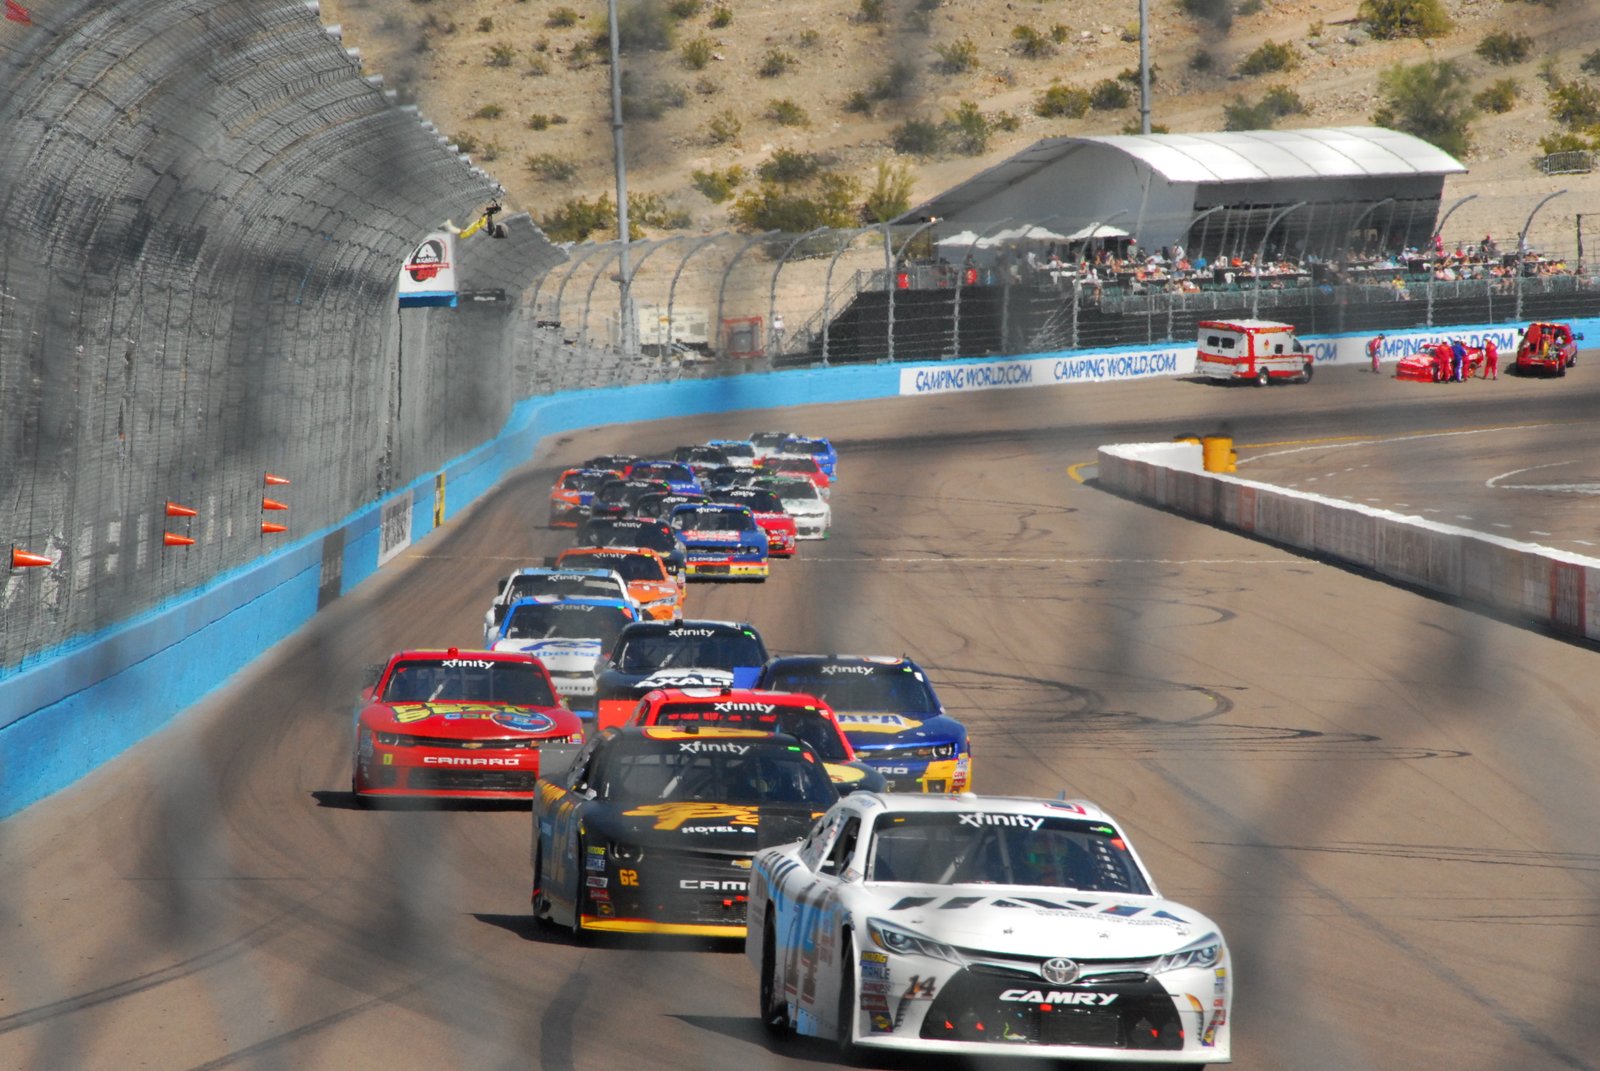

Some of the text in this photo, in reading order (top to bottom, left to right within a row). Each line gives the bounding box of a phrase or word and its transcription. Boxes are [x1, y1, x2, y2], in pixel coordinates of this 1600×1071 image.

[547, 574, 586, 582] xfinity
[551, 604, 595, 612] xfinity
[668, 628, 715, 637] xfinity
[441, 658, 495, 669] xfinity
[821, 665, 874, 676] xfinity
[634, 676, 734, 688] AXALT
[714, 701, 776, 714] xfinity
[838, 714, 903, 725] APA
[679, 741, 750, 755] xfinity
[423, 756, 520, 766] CAMARO
[958, 812, 1045, 831] xfinity
[681, 826, 738, 834] HOTEL
[619, 869, 640, 887] 62
[909, 974, 936, 998] 14
[999, 989, 1120, 1006] CAMRY
